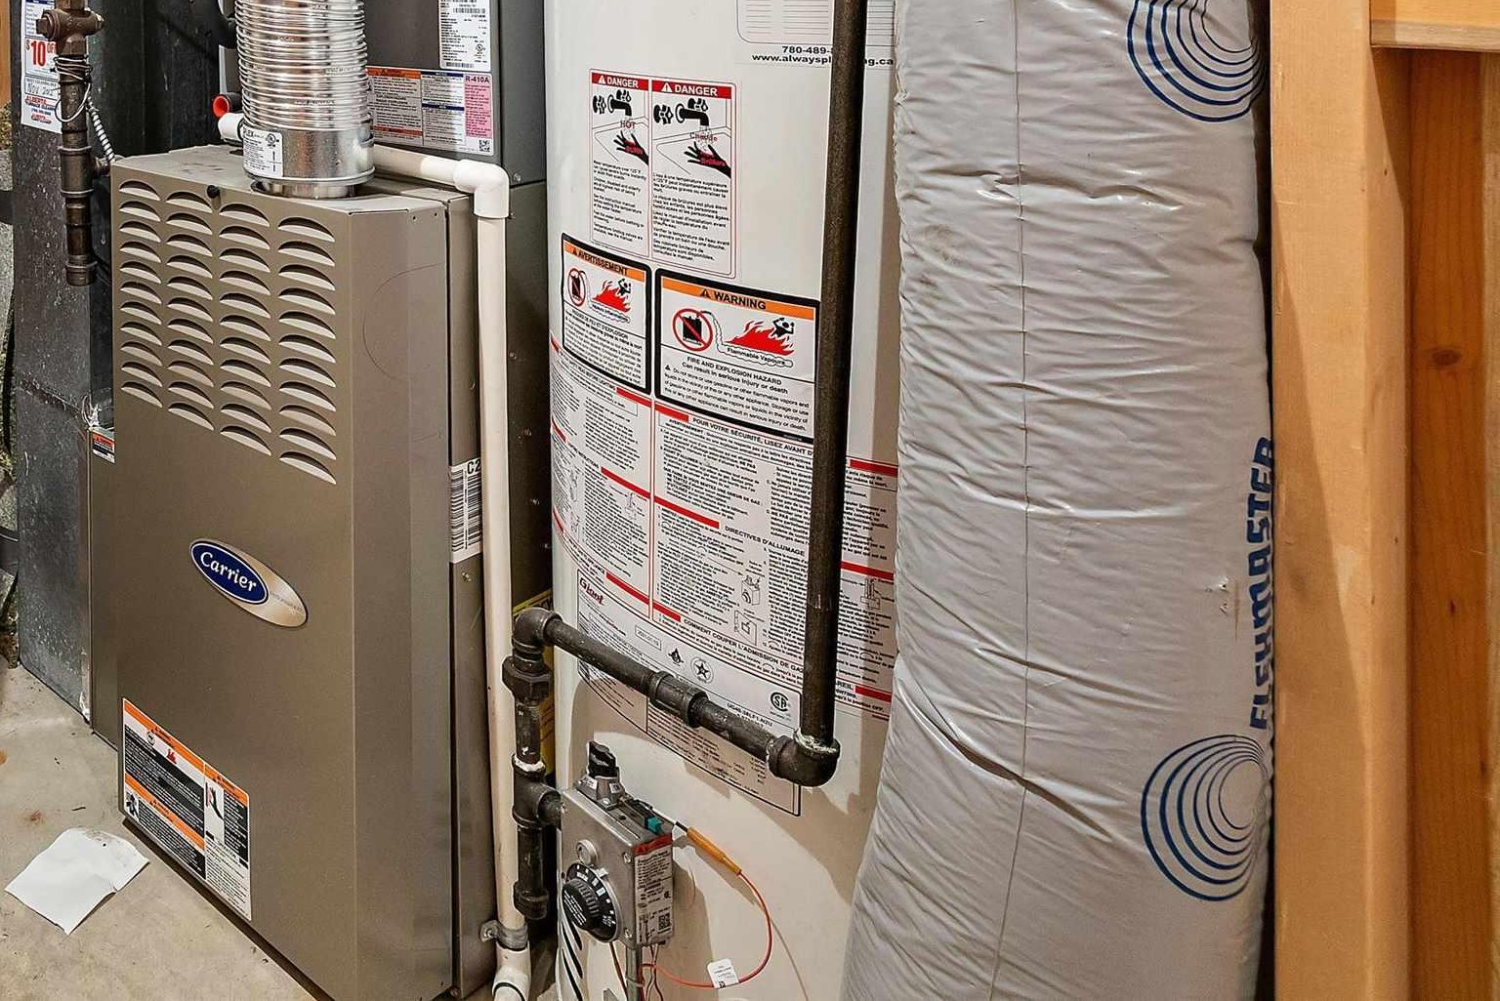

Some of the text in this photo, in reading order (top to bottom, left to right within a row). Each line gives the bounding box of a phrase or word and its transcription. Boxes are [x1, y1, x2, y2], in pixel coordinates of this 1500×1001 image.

[465, 75, 490, 83] R-410A
[607, 77, 639, 89] DANGER
[674, 84, 718, 97] DANGER
[713, 290, 767, 310] WARNING
[687, 356, 782, 385] FIRE AND EXPLOSION HAZARD
[200, 551, 257, 592] Carrier
